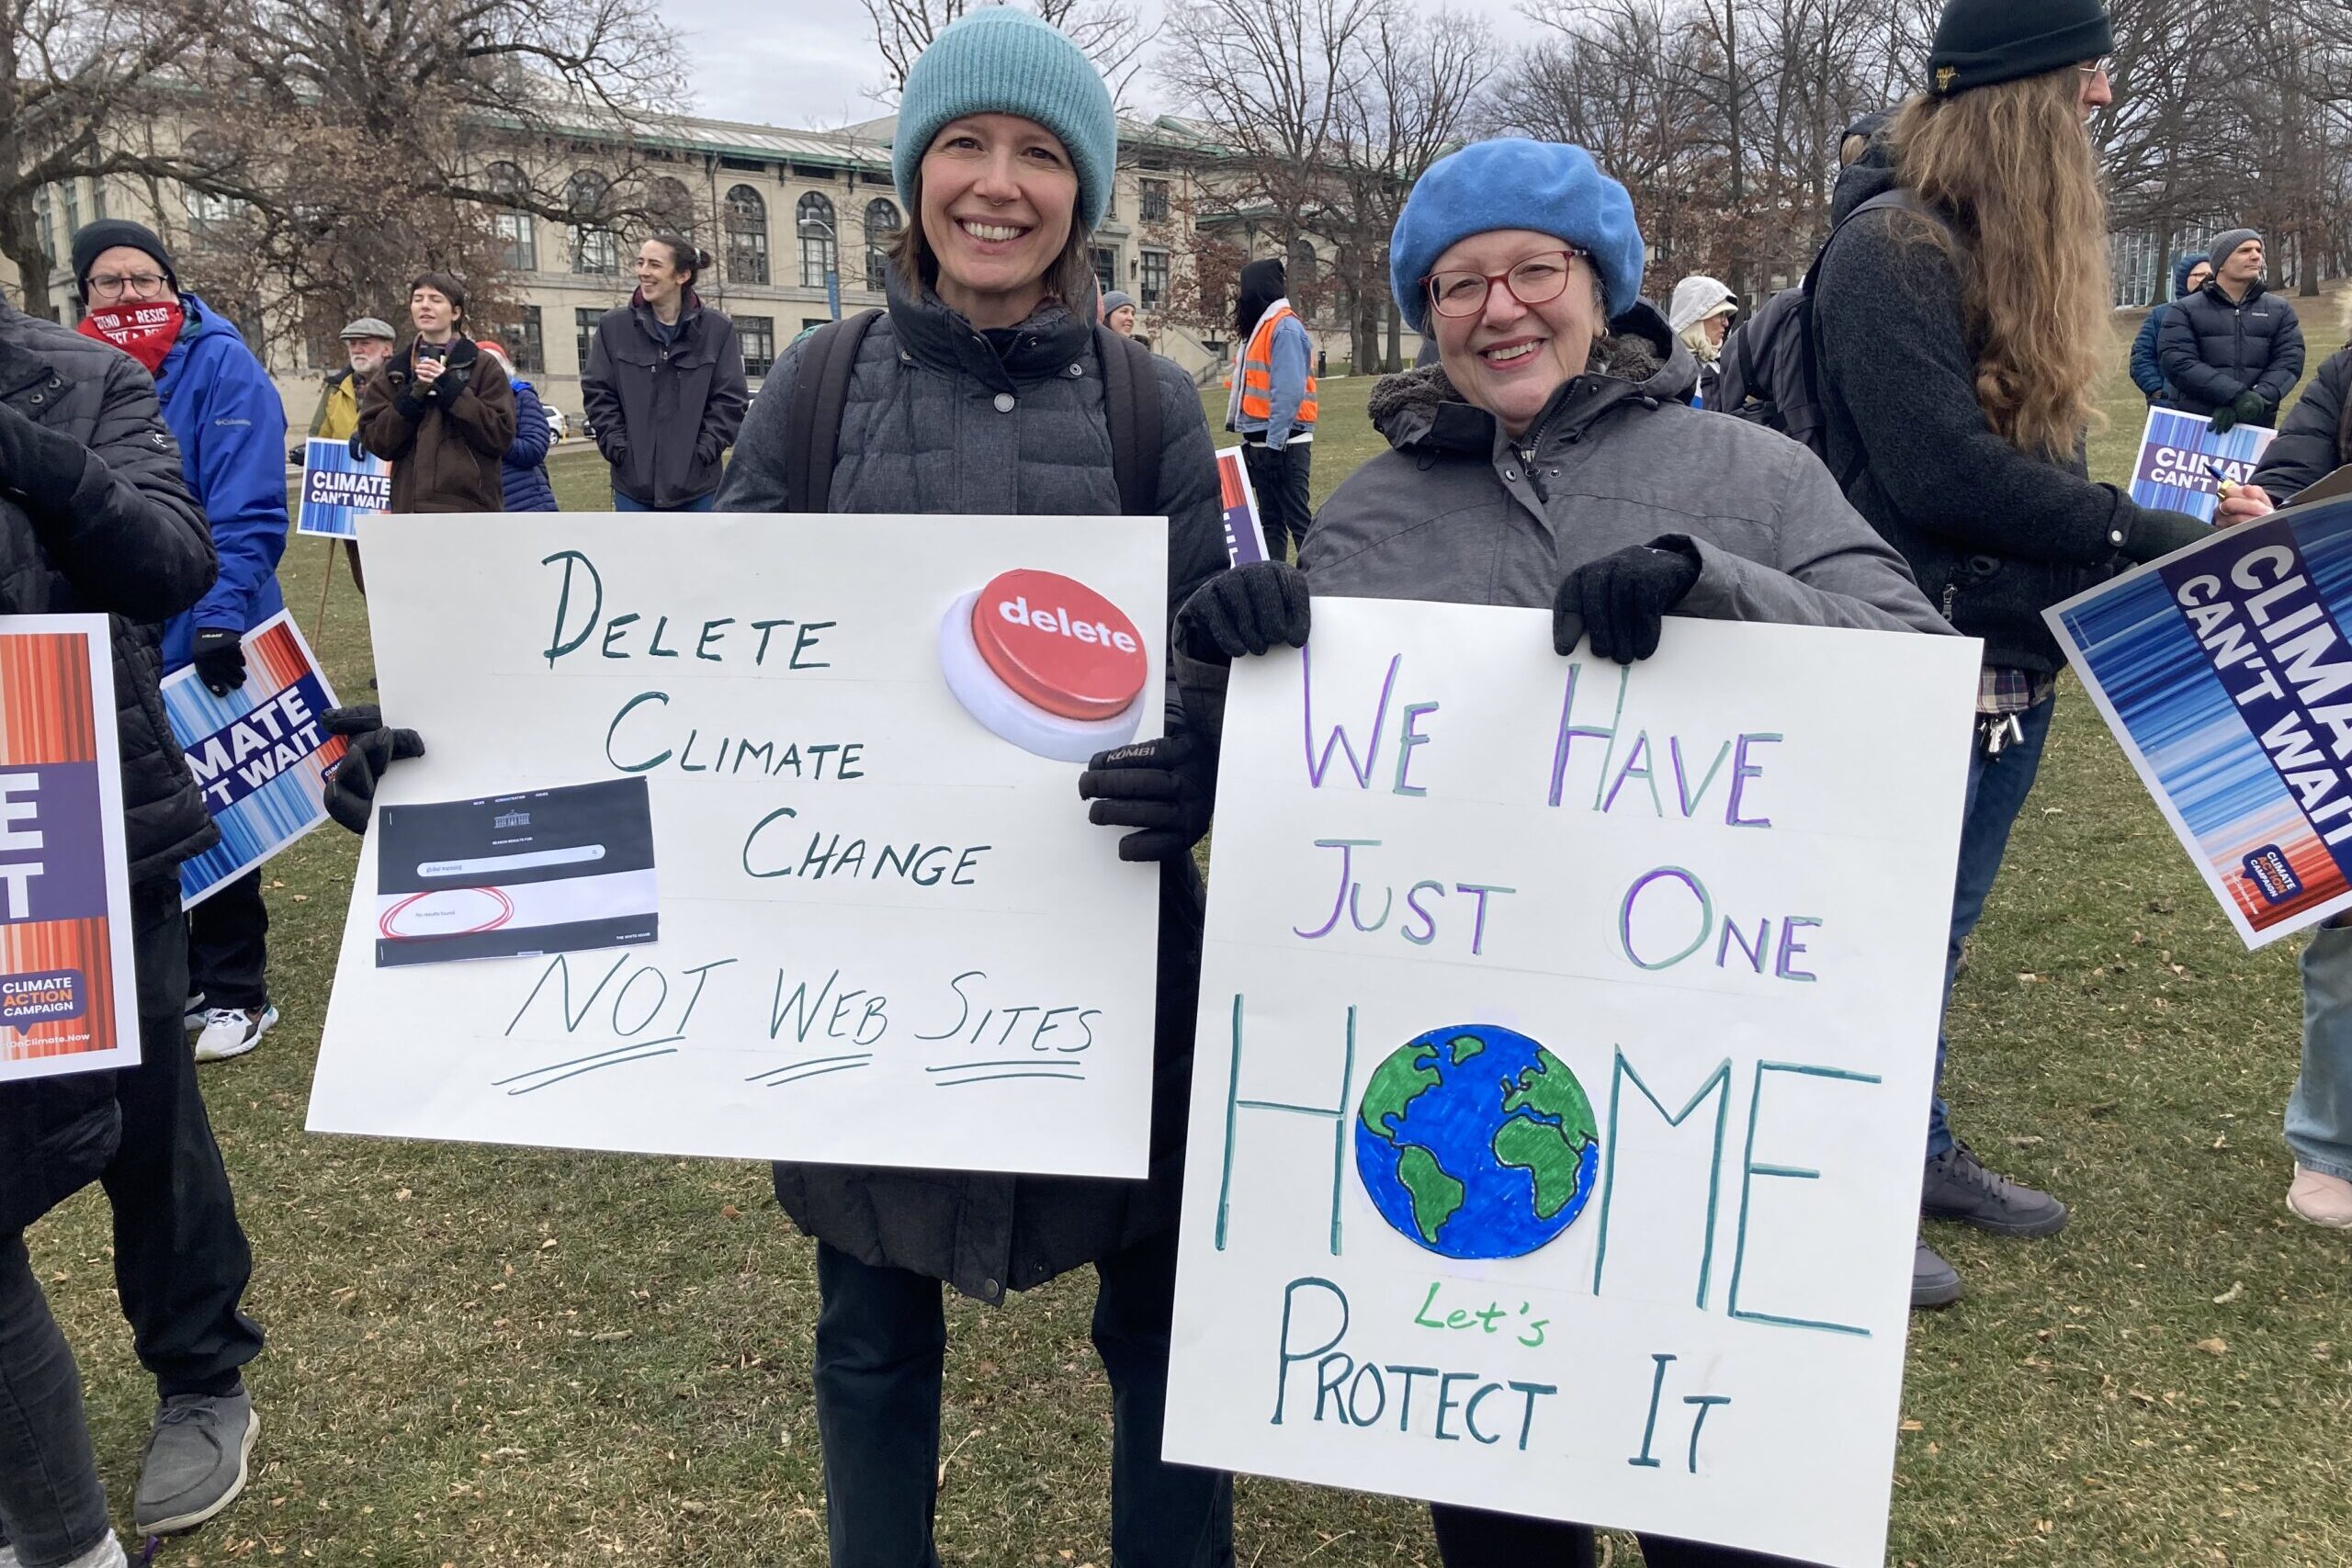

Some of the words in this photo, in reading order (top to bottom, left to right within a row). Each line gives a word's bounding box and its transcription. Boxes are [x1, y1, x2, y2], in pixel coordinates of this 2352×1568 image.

[312, 470, 391, 496] CLIMATE
[2151, 468, 2212, 491] CAN'T
[2155, 446, 2256, 484] CLIMAT
[311, 490, 351, 505] CAN'T
[353, 493, 390, 510] WAIT
[541, 549, 838, 671] DELETE
[999, 595, 1137, 653] delete
[2177, 574, 2285, 705] CAN'T
[185, 685, 312, 786] MATE
[237, 720, 321, 789] WAIT
[606, 691, 865, 781] CLIMATE
[1106, 746, 1156, 762] KOMBI
[1301, 641, 1442, 797] WE
[1548, 662, 1785, 828] HAVE
[742, 807, 992, 886] CHANGE
[2267, 852, 2297, 890] CLIMATE
[2250, 859, 2278, 897] CAMPAIGN
[1292, 839, 1517, 956] JUST
[1617, 863, 1825, 984] ONE
[2, 976, 73, 994] CLIMATE
[4, 988, 74, 1007] ACTION
[4, 1001, 74, 1017] CAMPAIGN
[504, 952, 739, 1036] NOT
[770, 967, 888, 1045] WEB
[913, 970, 1102, 1053] SITES
[1414, 1281, 1550, 1348] Let's
[1270, 1276, 1558, 1450] PROTECT
[1628, 1353, 1732, 1473] IT
